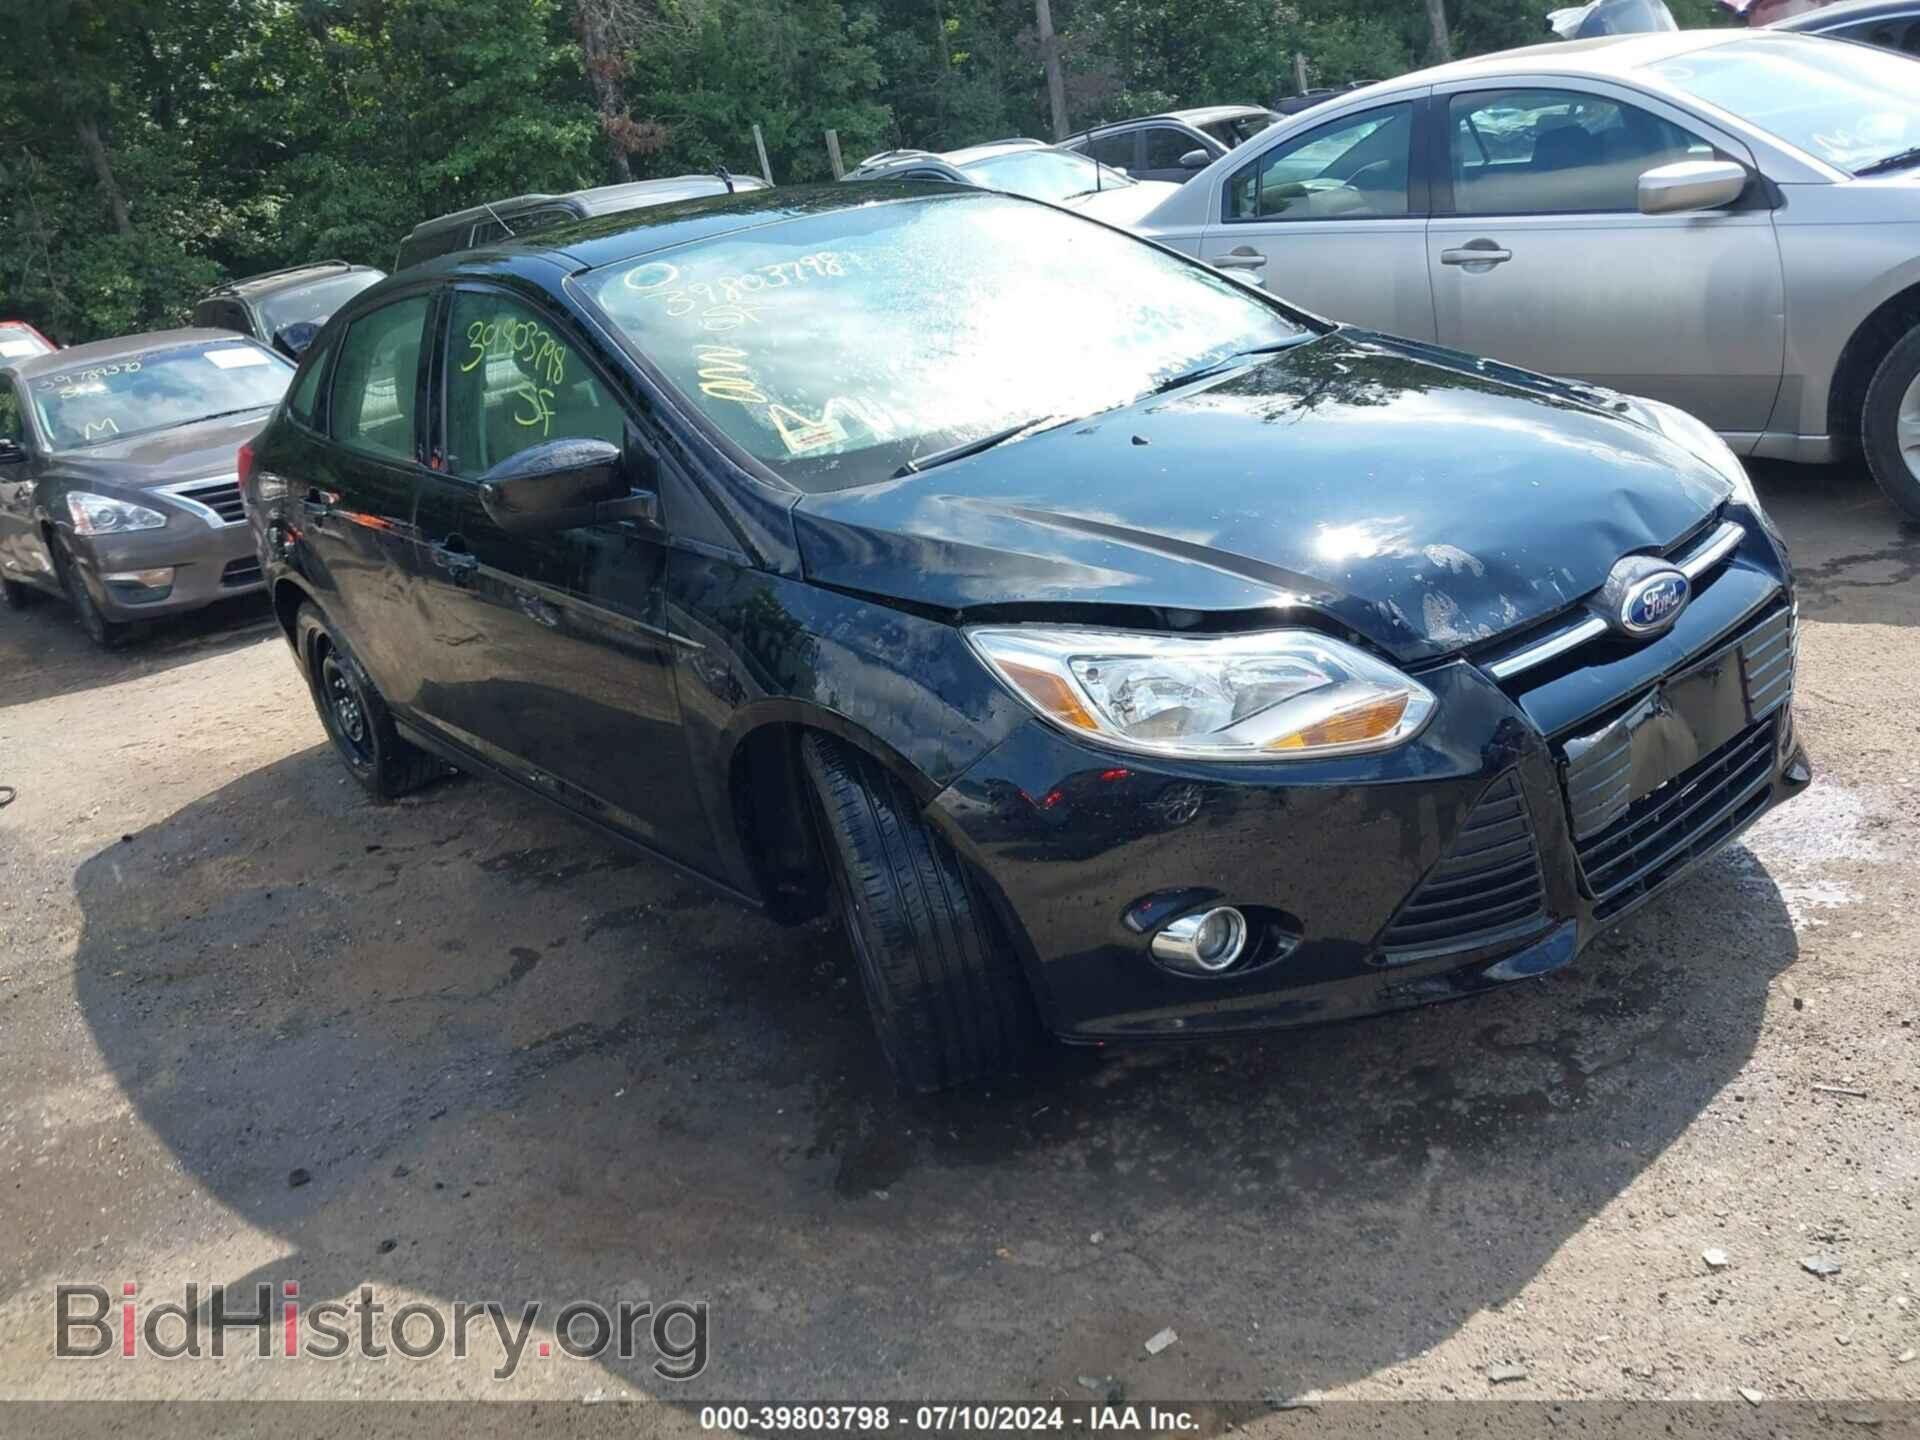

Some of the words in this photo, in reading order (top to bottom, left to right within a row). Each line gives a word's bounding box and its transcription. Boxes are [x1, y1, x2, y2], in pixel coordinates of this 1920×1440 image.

[643, 250, 850, 318] 39803798
[460, 320, 567, 385] 39803798
[85, 417, 120, 441] M
[1642, 582, 1681, 621] Ford
